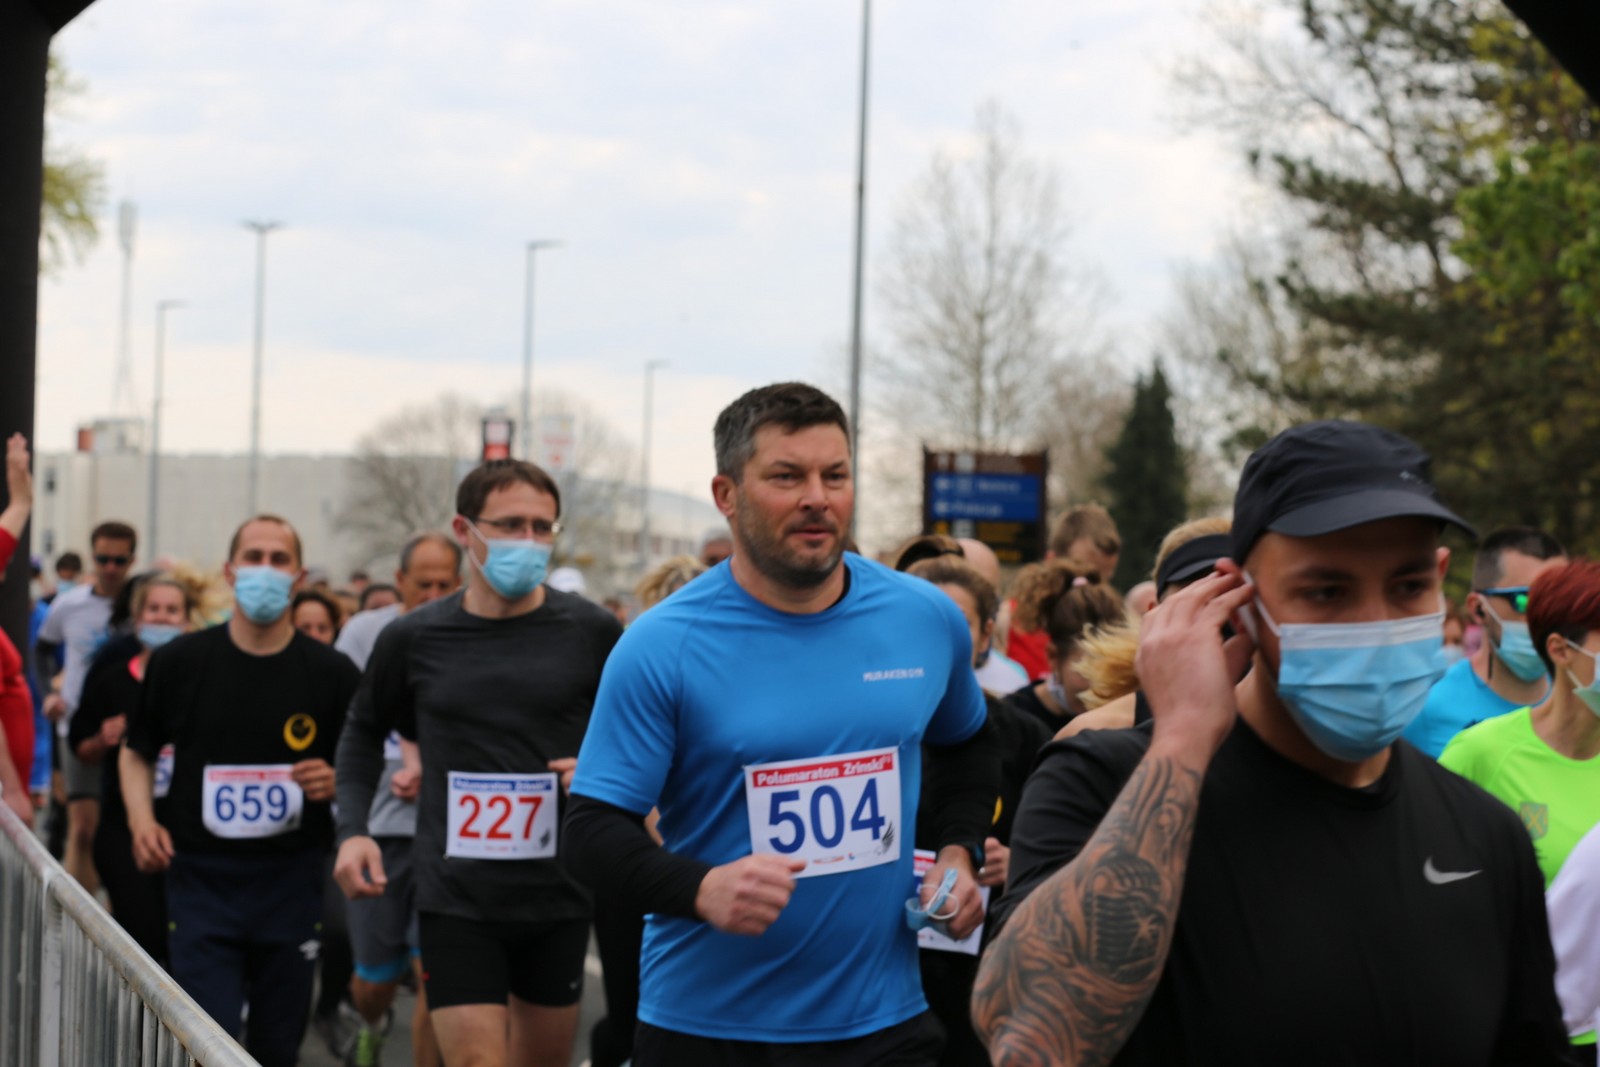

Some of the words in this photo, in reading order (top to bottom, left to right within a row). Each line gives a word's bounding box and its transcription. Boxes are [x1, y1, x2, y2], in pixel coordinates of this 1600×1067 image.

[757, 767, 839, 786] Polumaraton
[843, 759, 885, 775] Zrinski
[214, 784, 288, 822] 659
[458, 794, 543, 840] 227
[768, 777, 886, 854] 504
